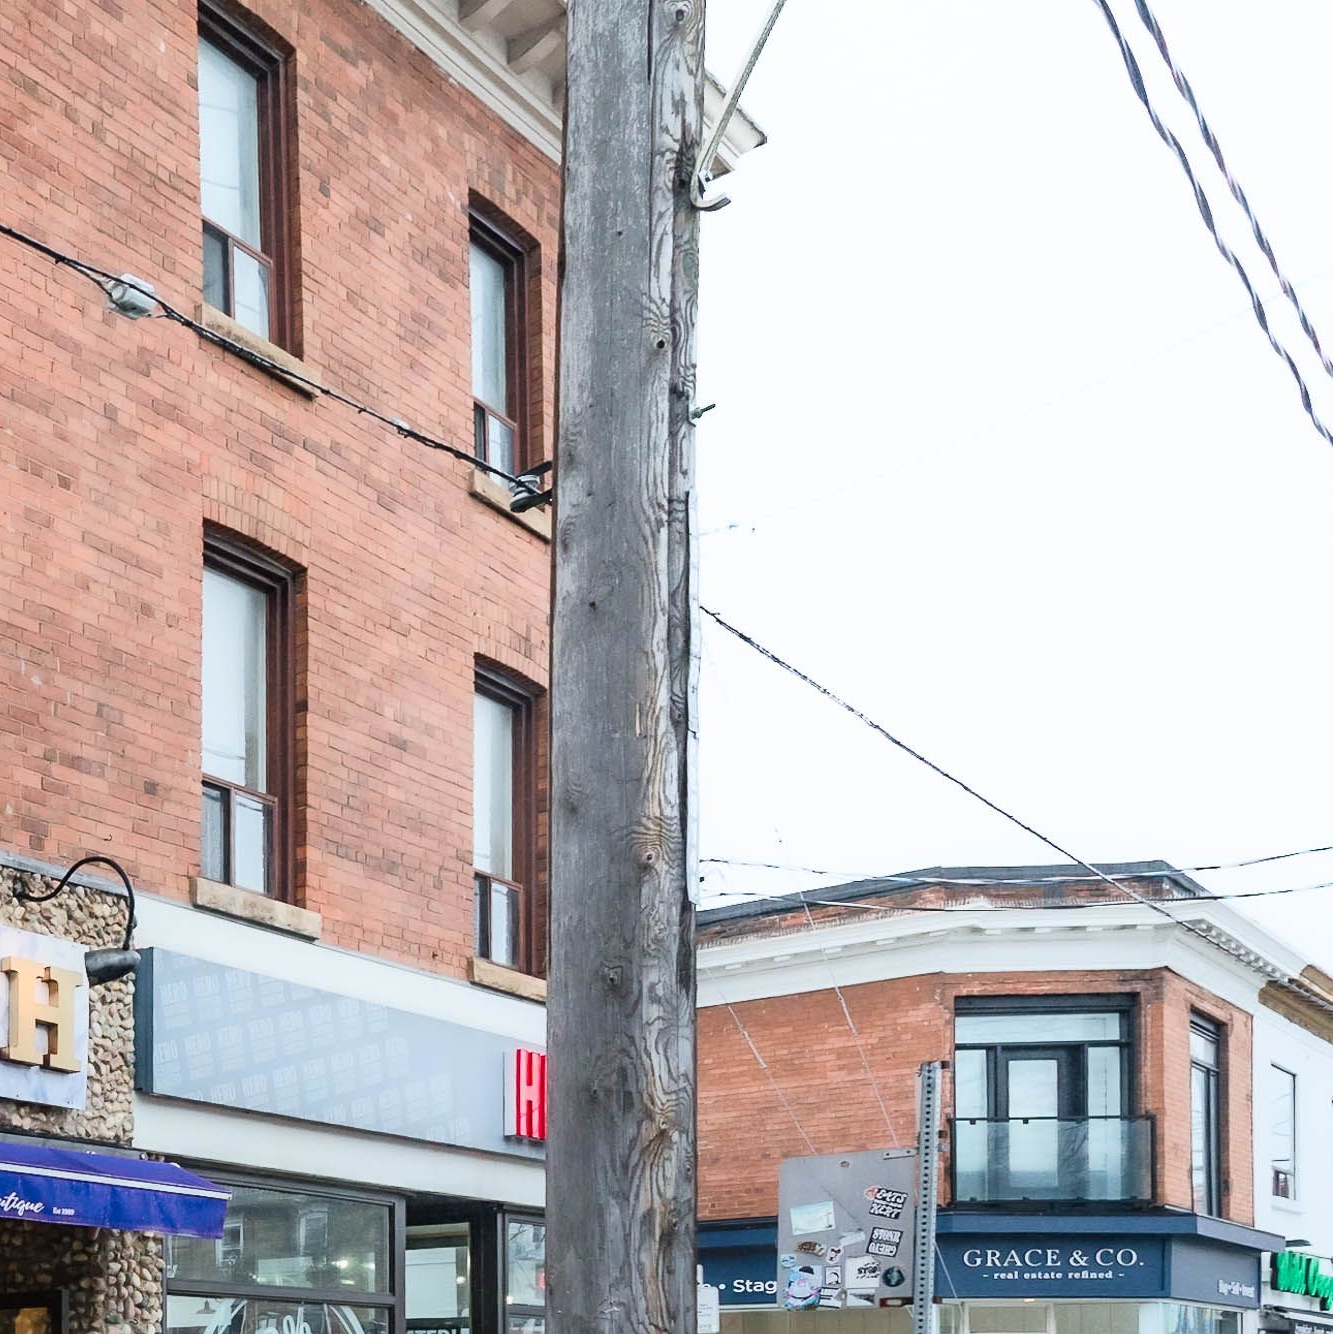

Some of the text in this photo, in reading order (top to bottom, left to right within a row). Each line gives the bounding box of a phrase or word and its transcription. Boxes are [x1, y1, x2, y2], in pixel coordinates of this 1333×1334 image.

[963, 1248, 1144, 1267] GRACE & CO.
[993, 1270, 1113, 1280] real estate refined
